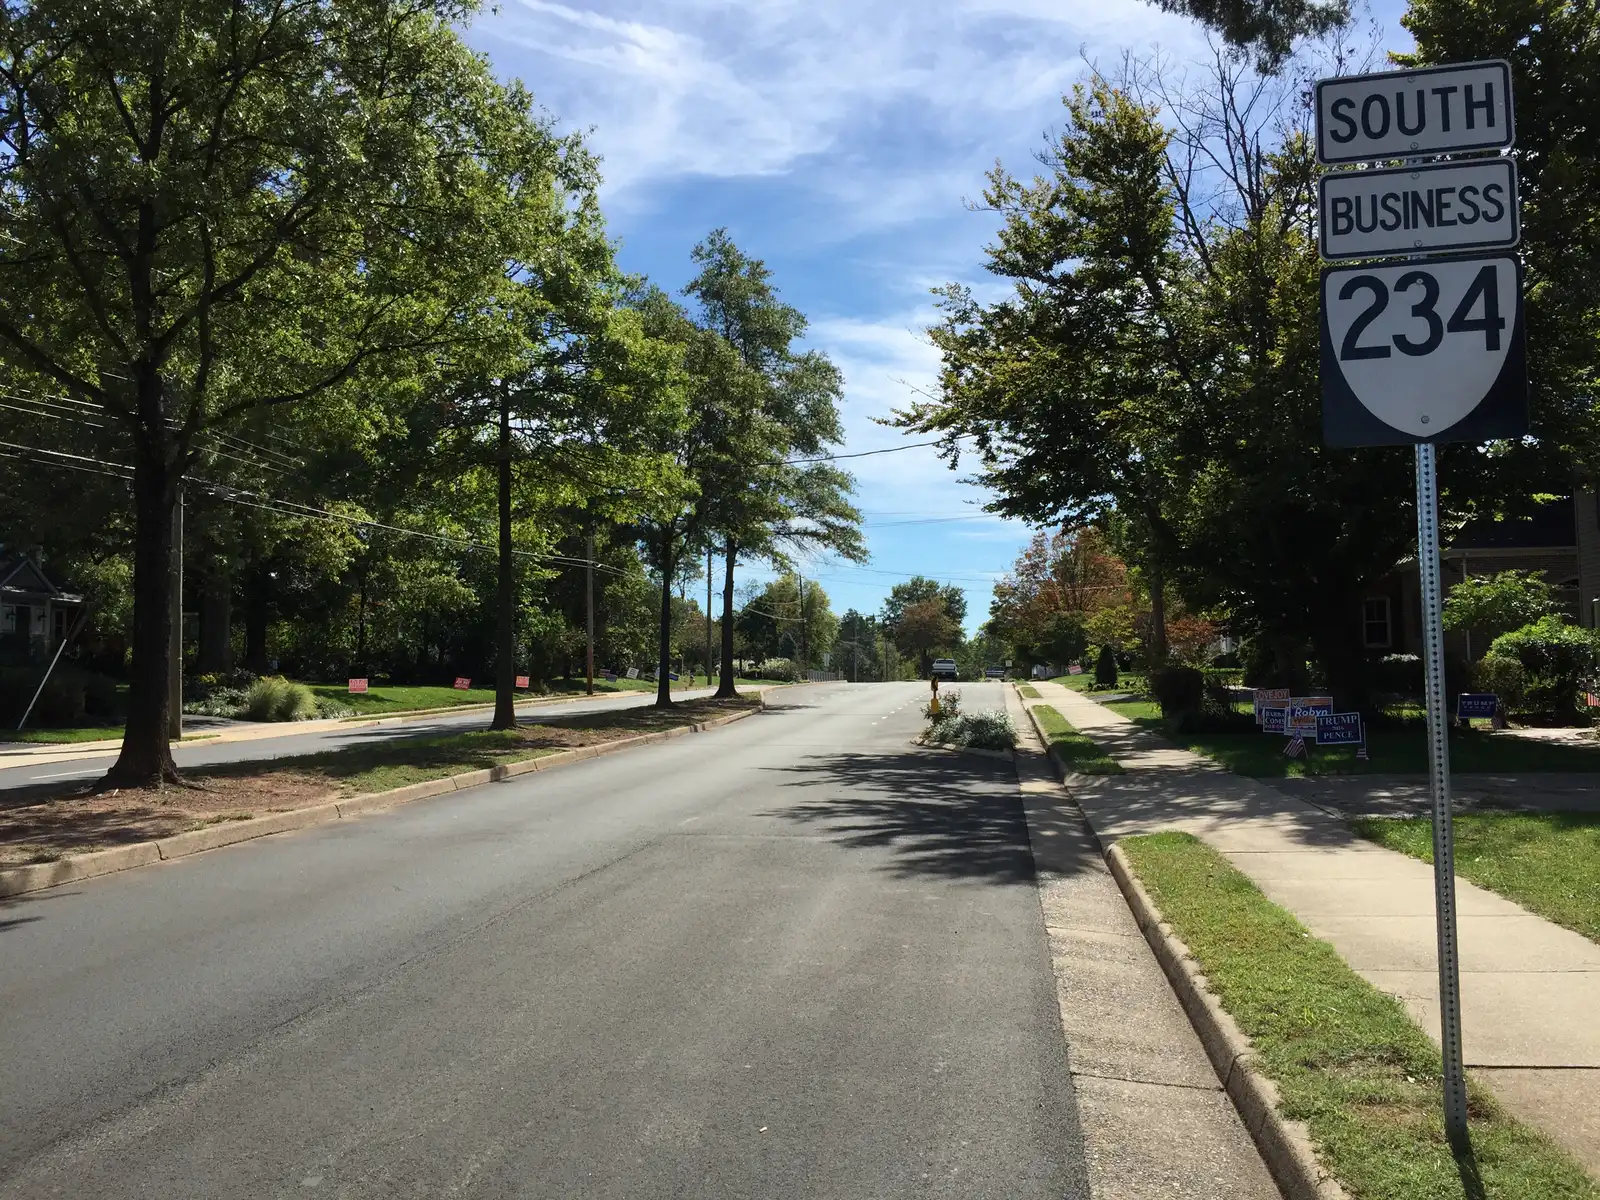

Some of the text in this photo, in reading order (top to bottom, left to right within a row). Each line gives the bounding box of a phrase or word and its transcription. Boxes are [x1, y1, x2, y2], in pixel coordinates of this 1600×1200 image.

[1329, 82, 1496, 144] SOUTH
[1331, 183, 1505, 236] BUSINESS
[1338, 265, 1506, 361] 234
[1294, 706, 1328, 716] Robyn
[1317, 715, 1357, 726] TRUMP
[1323, 731, 1354, 739] PENCE
